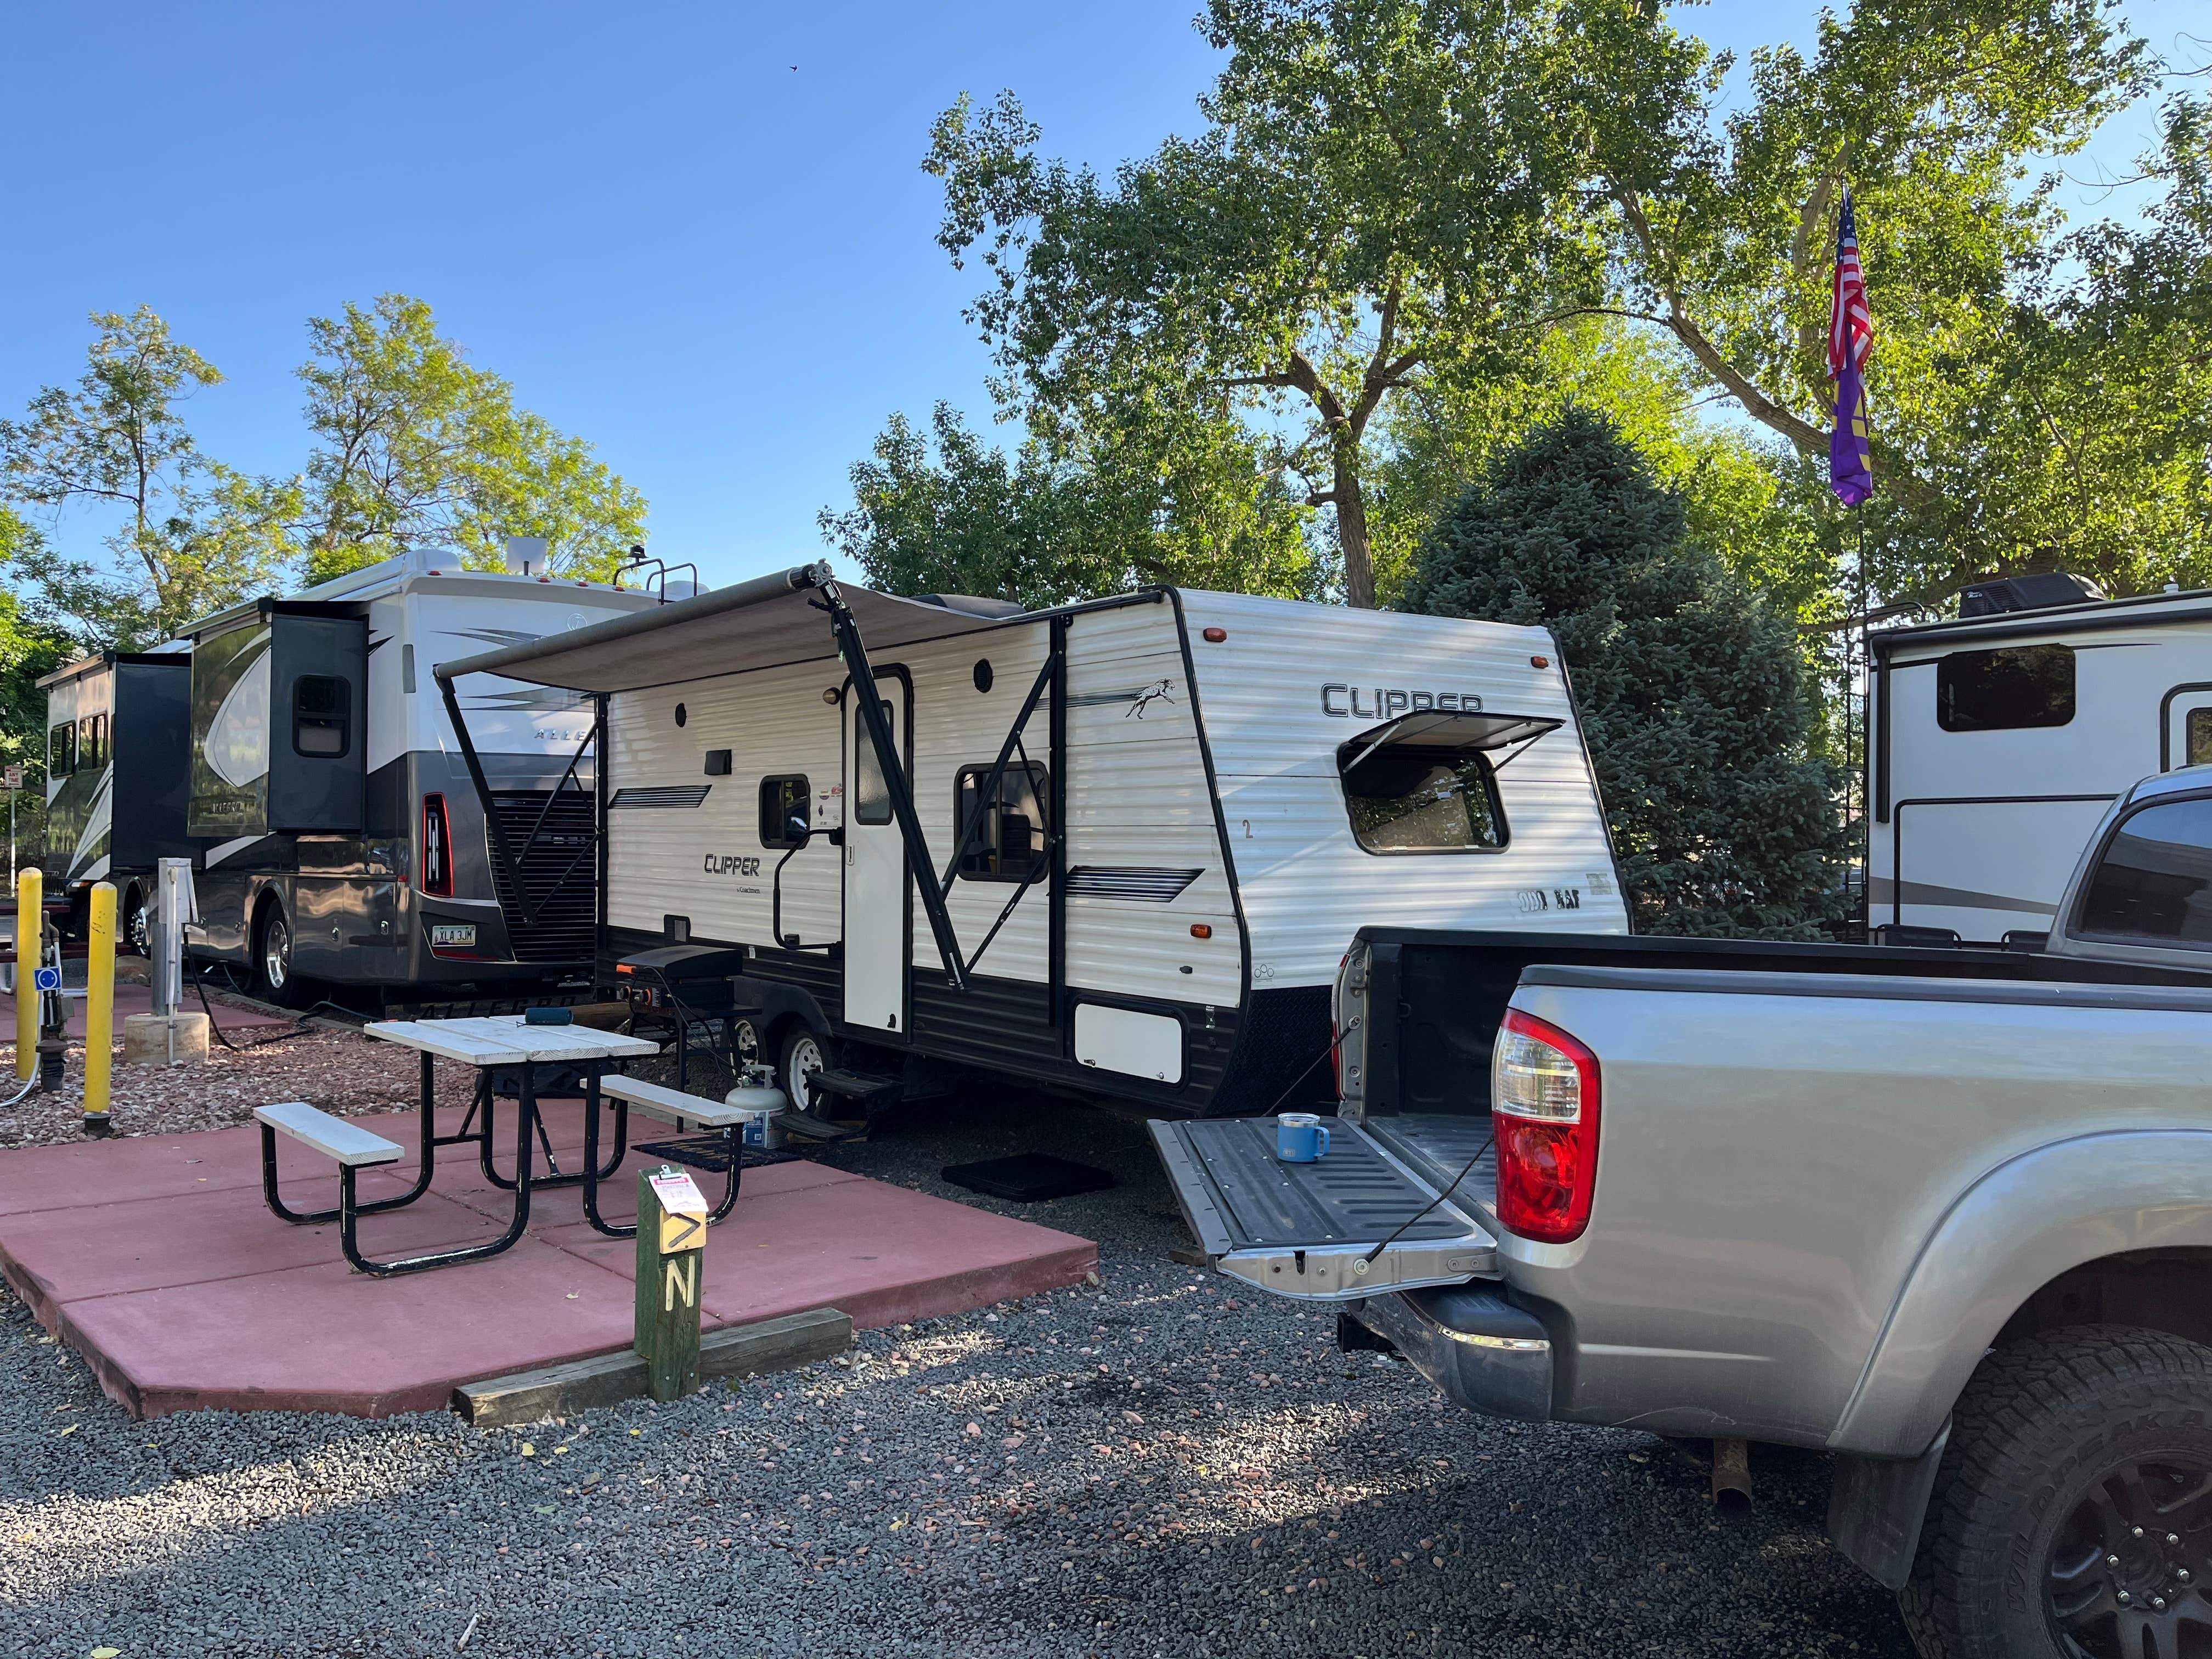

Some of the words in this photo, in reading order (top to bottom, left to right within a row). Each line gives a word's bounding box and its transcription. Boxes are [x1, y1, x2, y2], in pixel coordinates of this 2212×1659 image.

[533, 729, 595, 742] ALLE
[704, 854, 760, 877] CLIPPER
[439, 930, 454, 941] XLA
[457, 930, 472, 940] 3JM
[665, 1255, 696, 1312] N
